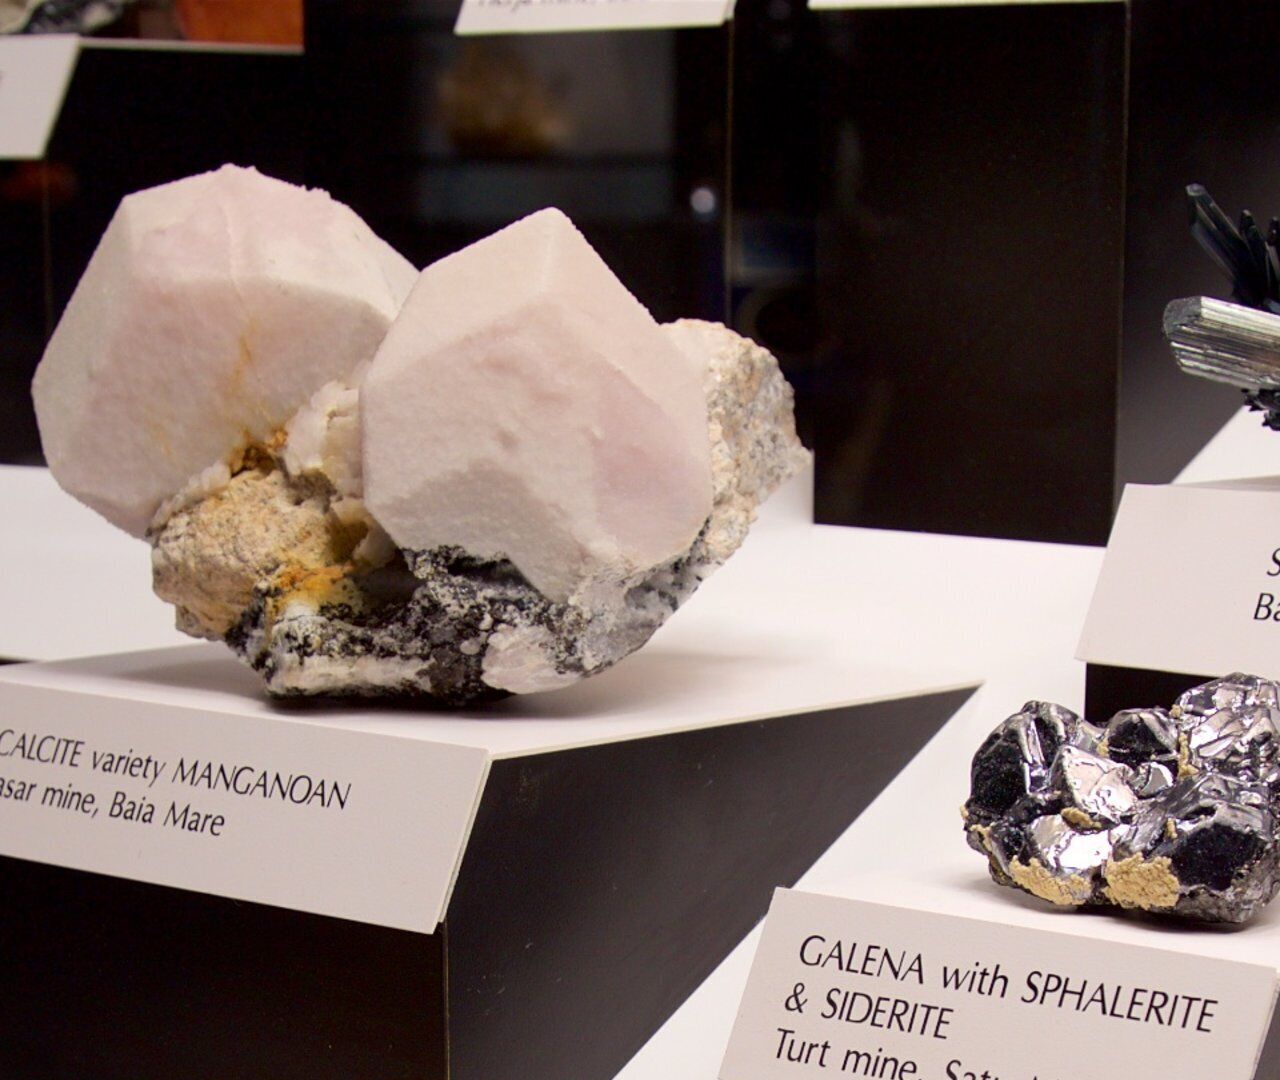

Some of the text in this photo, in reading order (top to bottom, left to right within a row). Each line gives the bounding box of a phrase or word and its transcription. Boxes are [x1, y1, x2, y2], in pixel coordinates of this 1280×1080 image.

[92, 750, 167, 788] variety
[171, 757, 352, 811] MANGANOAN
[40, 786, 99, 819] mine,
[108, 790, 156, 824] Baia
[162, 800, 226, 837] Mare
[784, 982, 955, 1040] & SIDERITE
[799, 934, 1219, 1034] GALENA with SPHALERITE
[775, 1027, 832, 1068] Turt
